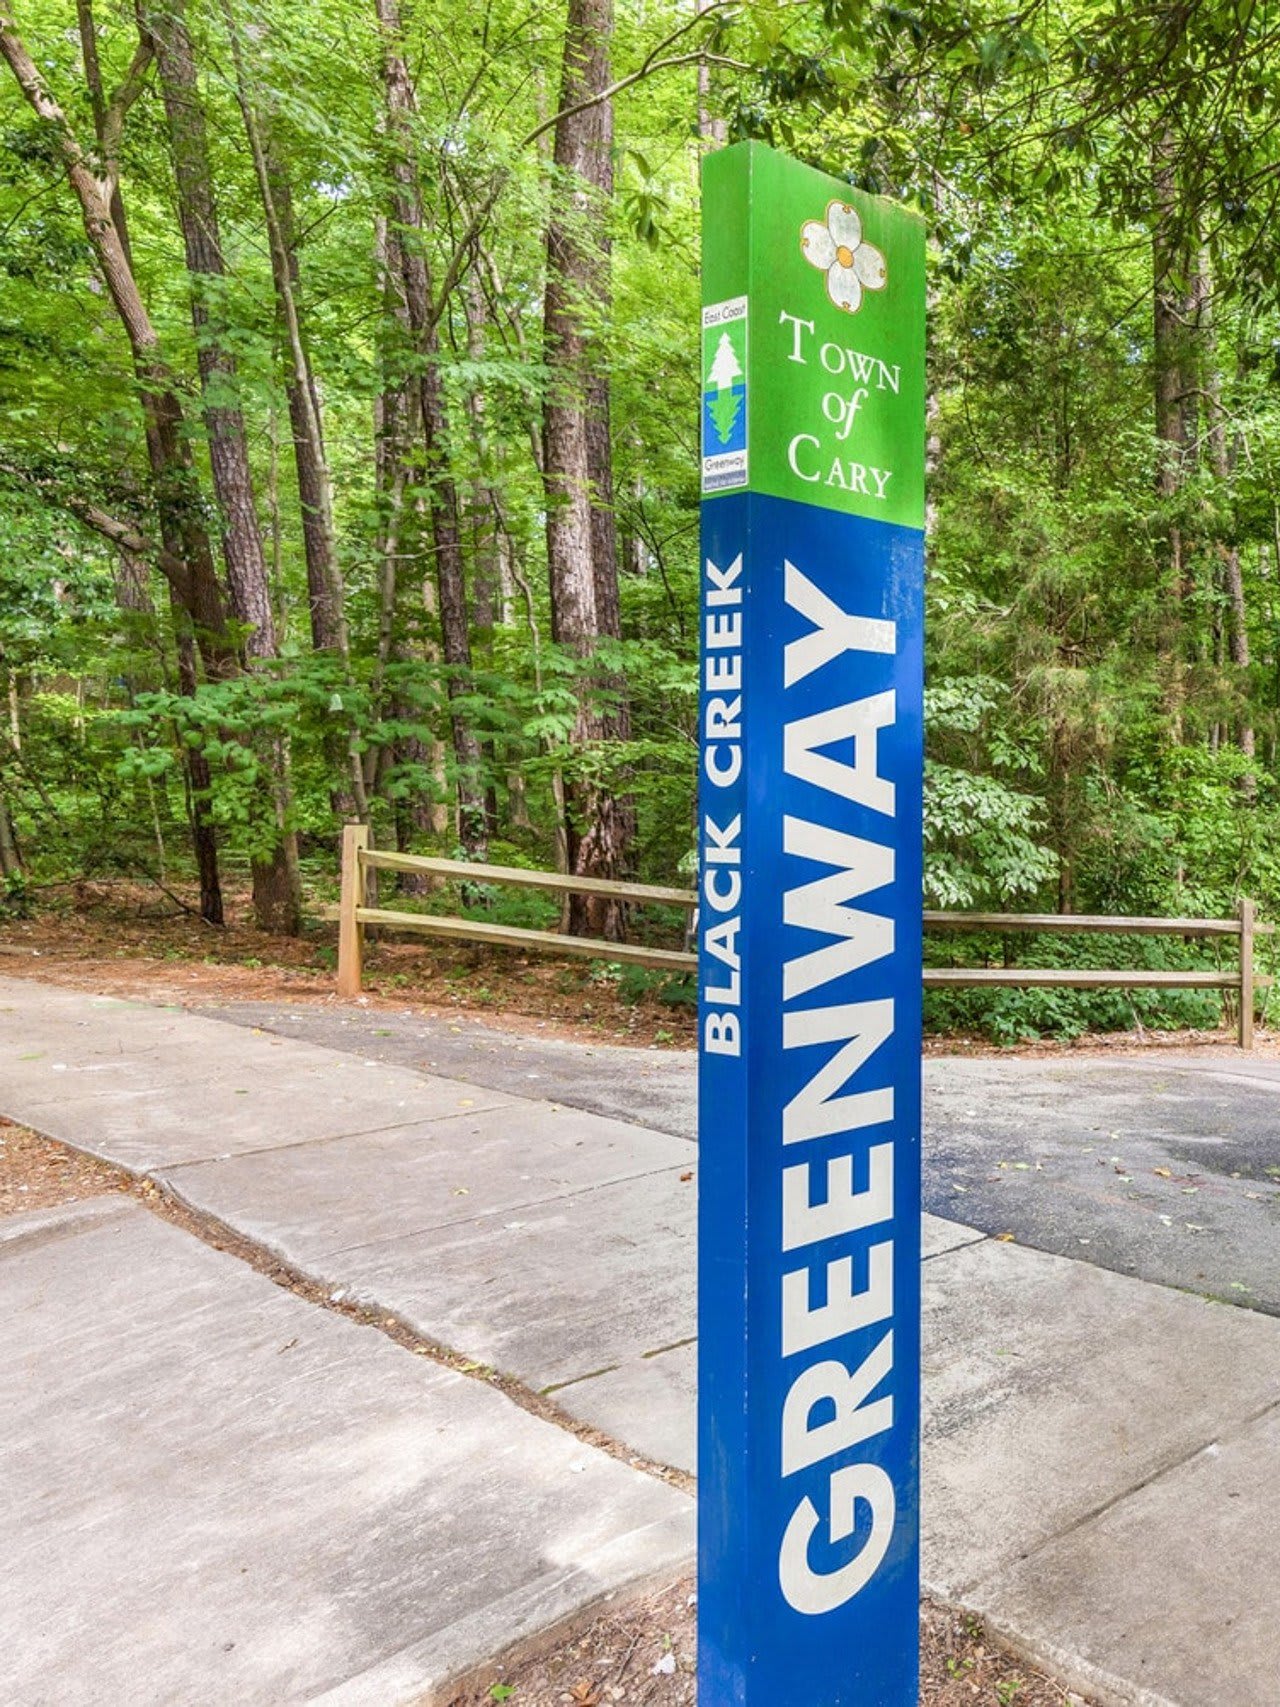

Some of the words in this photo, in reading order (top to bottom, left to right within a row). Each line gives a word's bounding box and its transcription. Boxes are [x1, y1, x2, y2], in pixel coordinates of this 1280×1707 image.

[704, 311, 720, 325] East
[722, 304, 746, 320] Coast
[779, 310, 901, 395] TOWN
[822, 387, 868, 441] of
[704, 456, 745, 471] Greenway
[787, 433, 892, 499] CARY
[704, 551, 743, 788] CREEK
[704, 812, 742, 1056] BLACK
[779, 559, 897, 1615] GREENWAY
